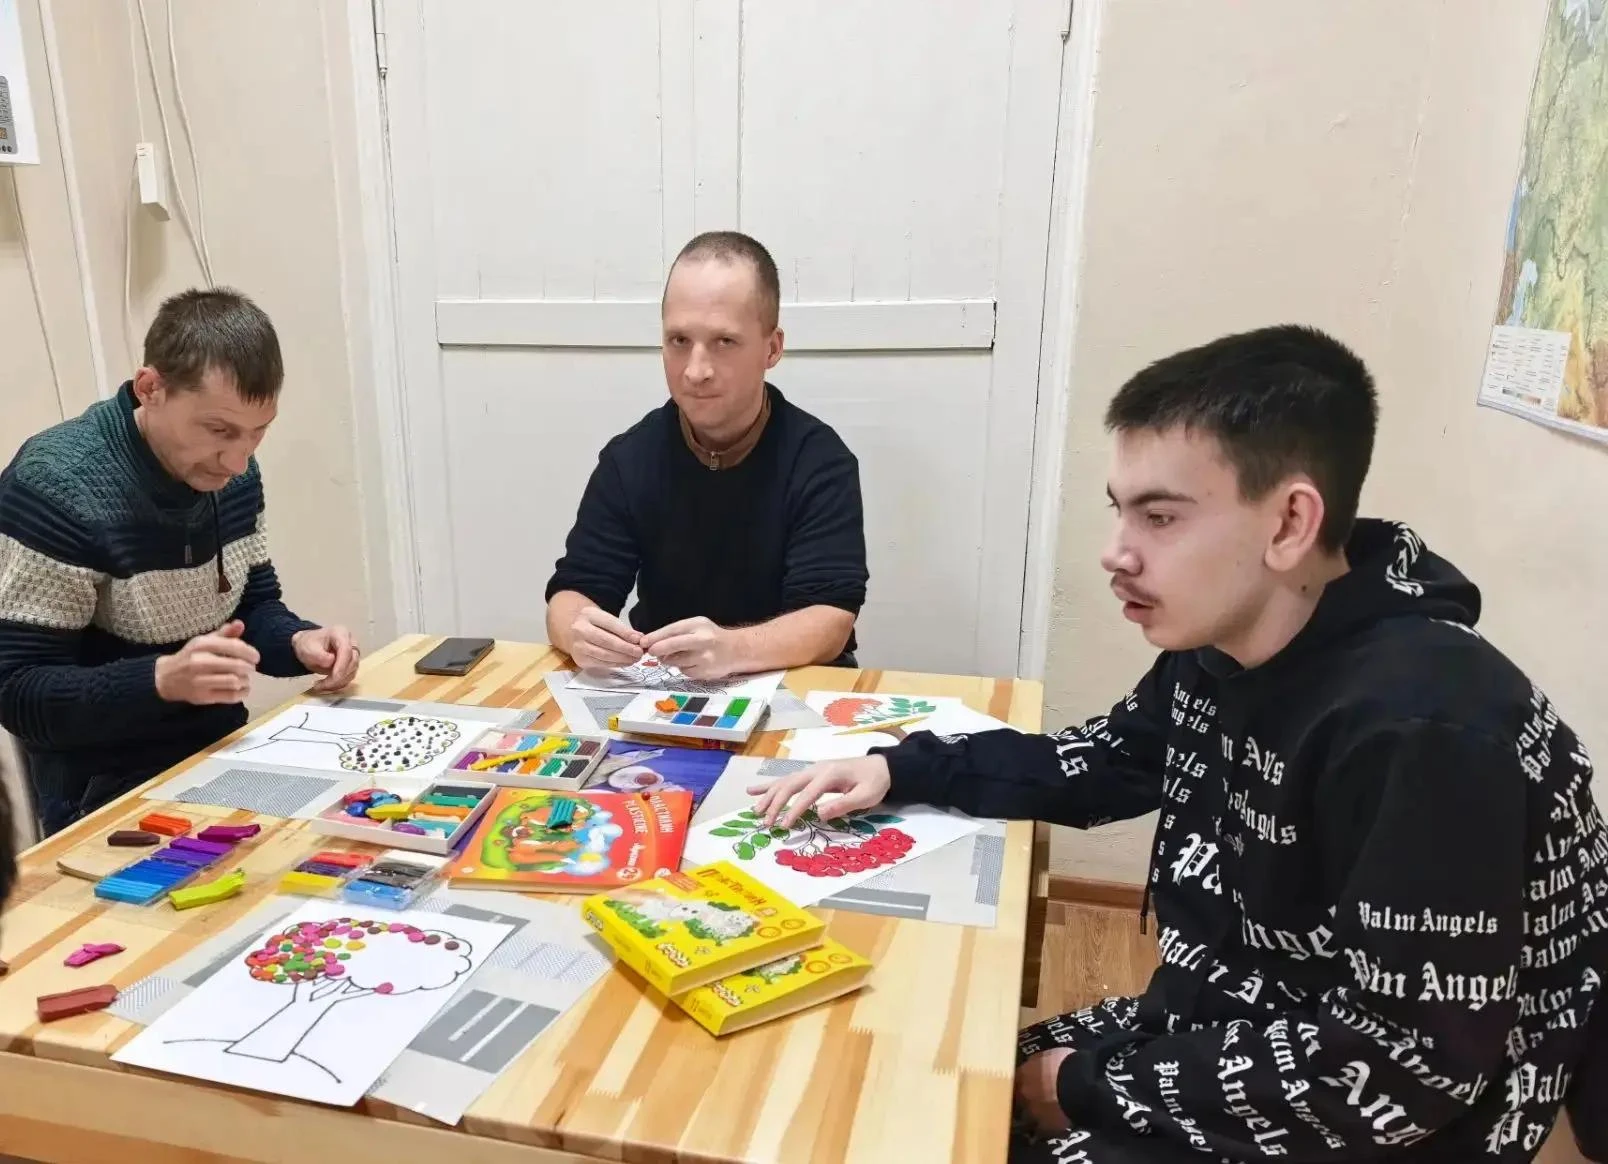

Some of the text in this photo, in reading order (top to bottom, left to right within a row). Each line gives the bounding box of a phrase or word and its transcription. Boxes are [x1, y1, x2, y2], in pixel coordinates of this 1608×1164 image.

[1358, 901, 1499, 938] Palm Angels
[1153, 1060, 1183, 1114] Palm
